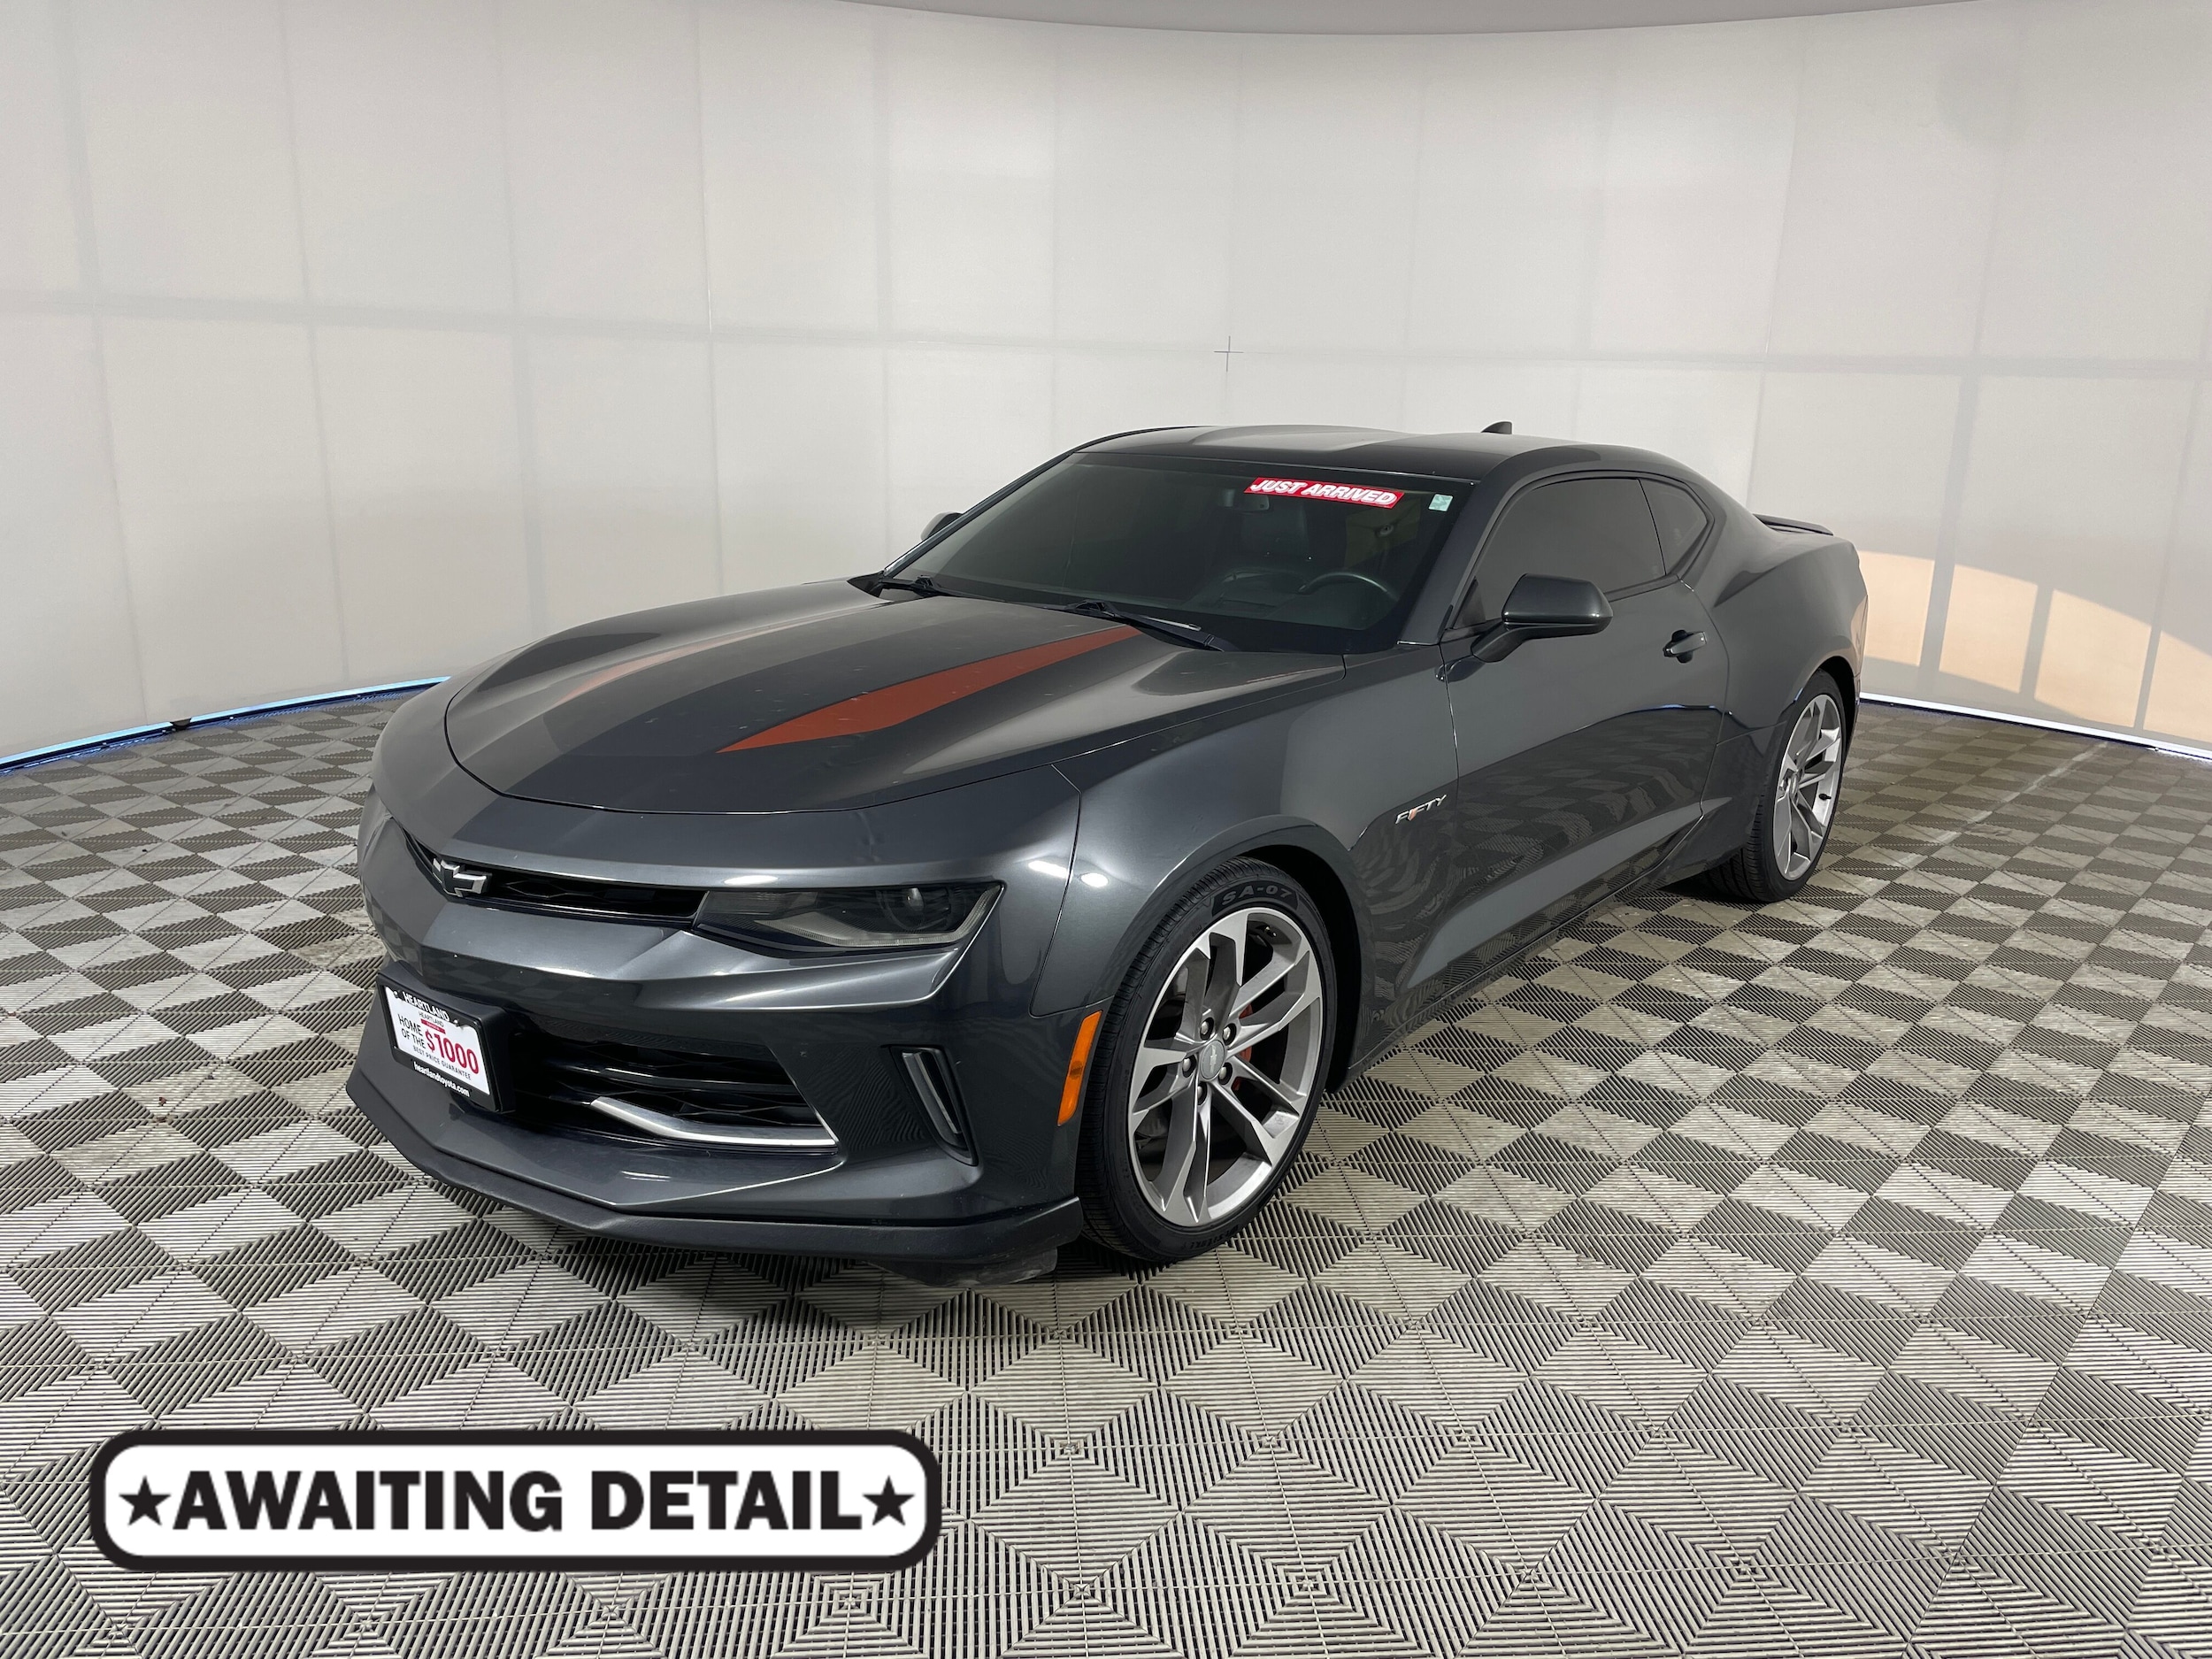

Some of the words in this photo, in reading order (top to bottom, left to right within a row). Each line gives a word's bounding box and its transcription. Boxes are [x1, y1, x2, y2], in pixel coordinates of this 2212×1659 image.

[1249, 479, 1308, 495] JUST
[1300, 483, 1398, 505] ARRIVED
[1222, 885, 1292, 906] SA-07
[402, 991, 450, 1022] HEARTLAND
[397, 1014, 424, 1036] HOME
[401, 1028, 411, 1040] OF
[411, 1033, 426, 1049] THE
[425, 1029, 479, 1074] $1000
[413, 1061, 471, 1097] heartlandtoyota.com
